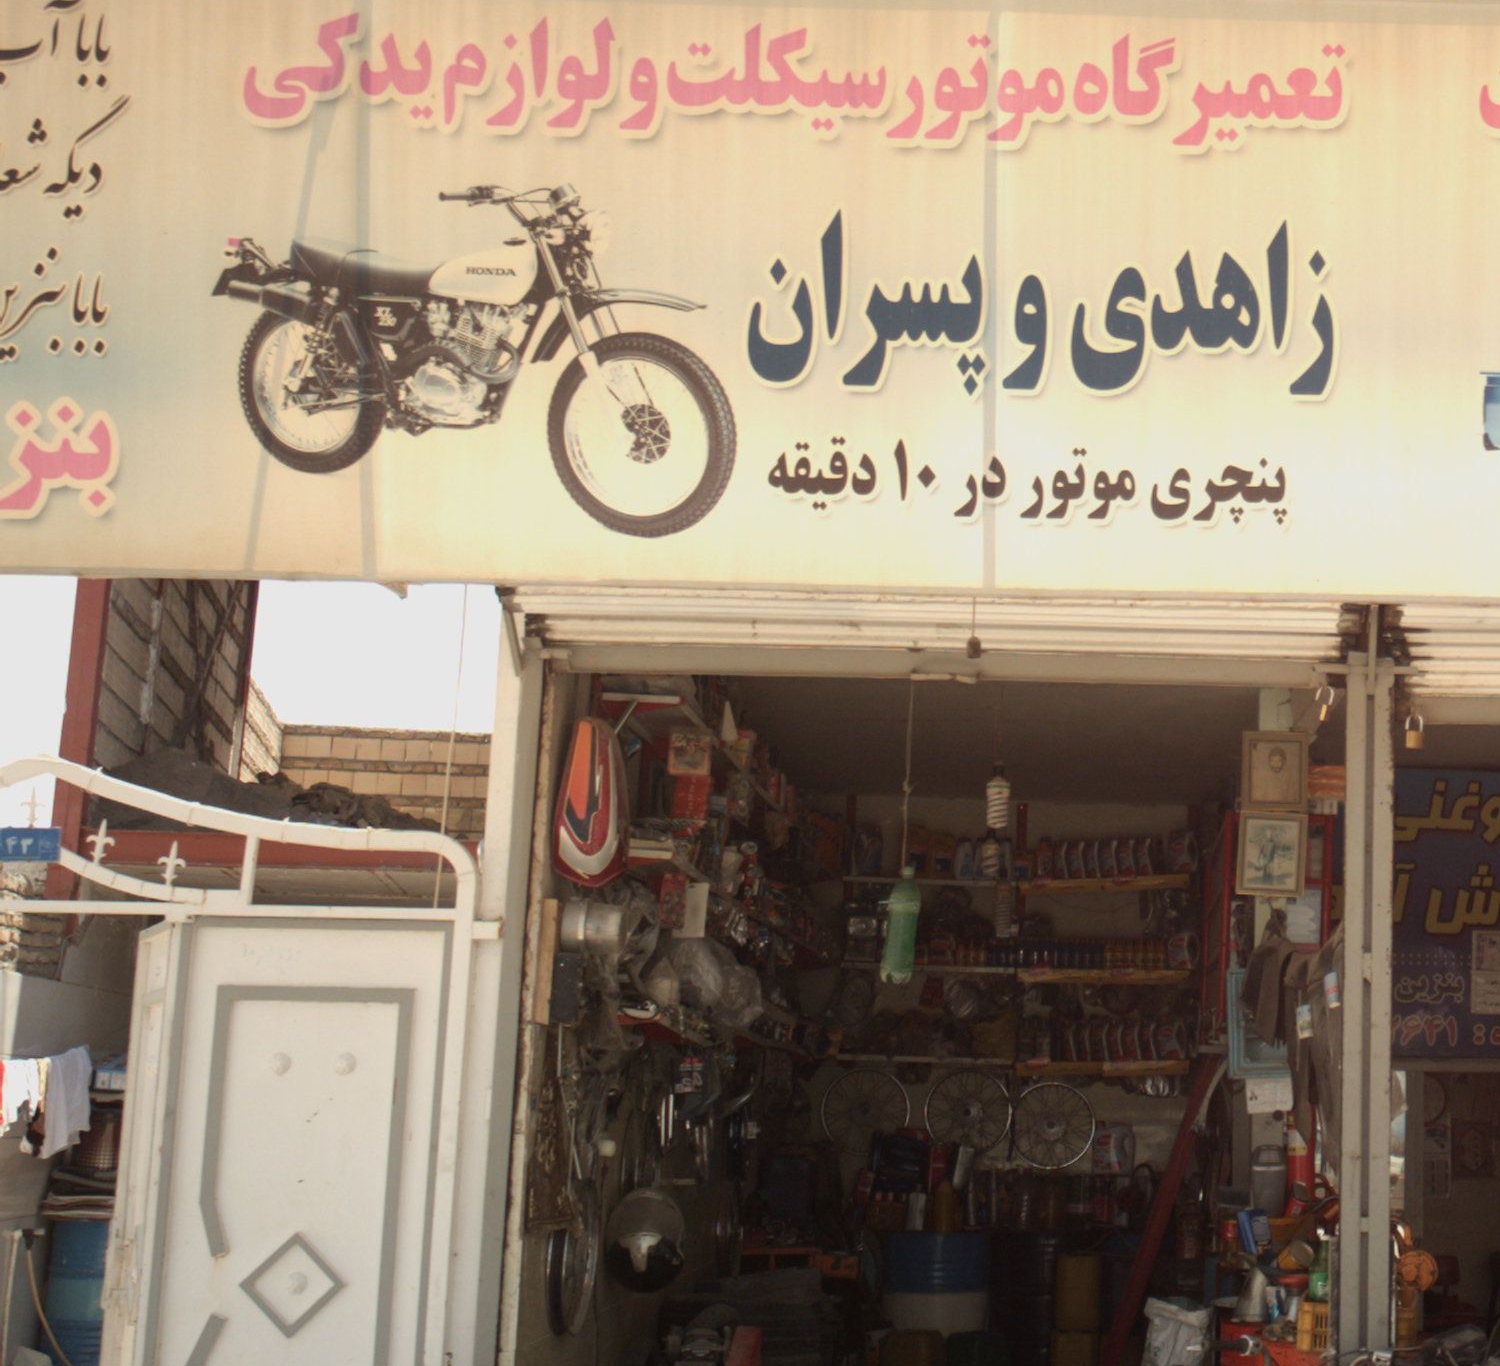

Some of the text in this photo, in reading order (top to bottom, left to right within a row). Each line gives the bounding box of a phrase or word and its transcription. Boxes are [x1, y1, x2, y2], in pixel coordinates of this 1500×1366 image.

[74, 13, 110, 87] بابا
[243, 12, 432, 121] یدکی
[442, 17, 614, 128] لوازم
[619, 50, 657, 131] و
[43, 95, 131, 218] دیگه
[74, 274, 109, 354] بابا
[466, 266, 517, 277] HONDA
[747, 208, 1336, 396] زاهدی و پسران
[767, 438, 1287, 524] پنچری موتور در ۱۰ دقیقه
